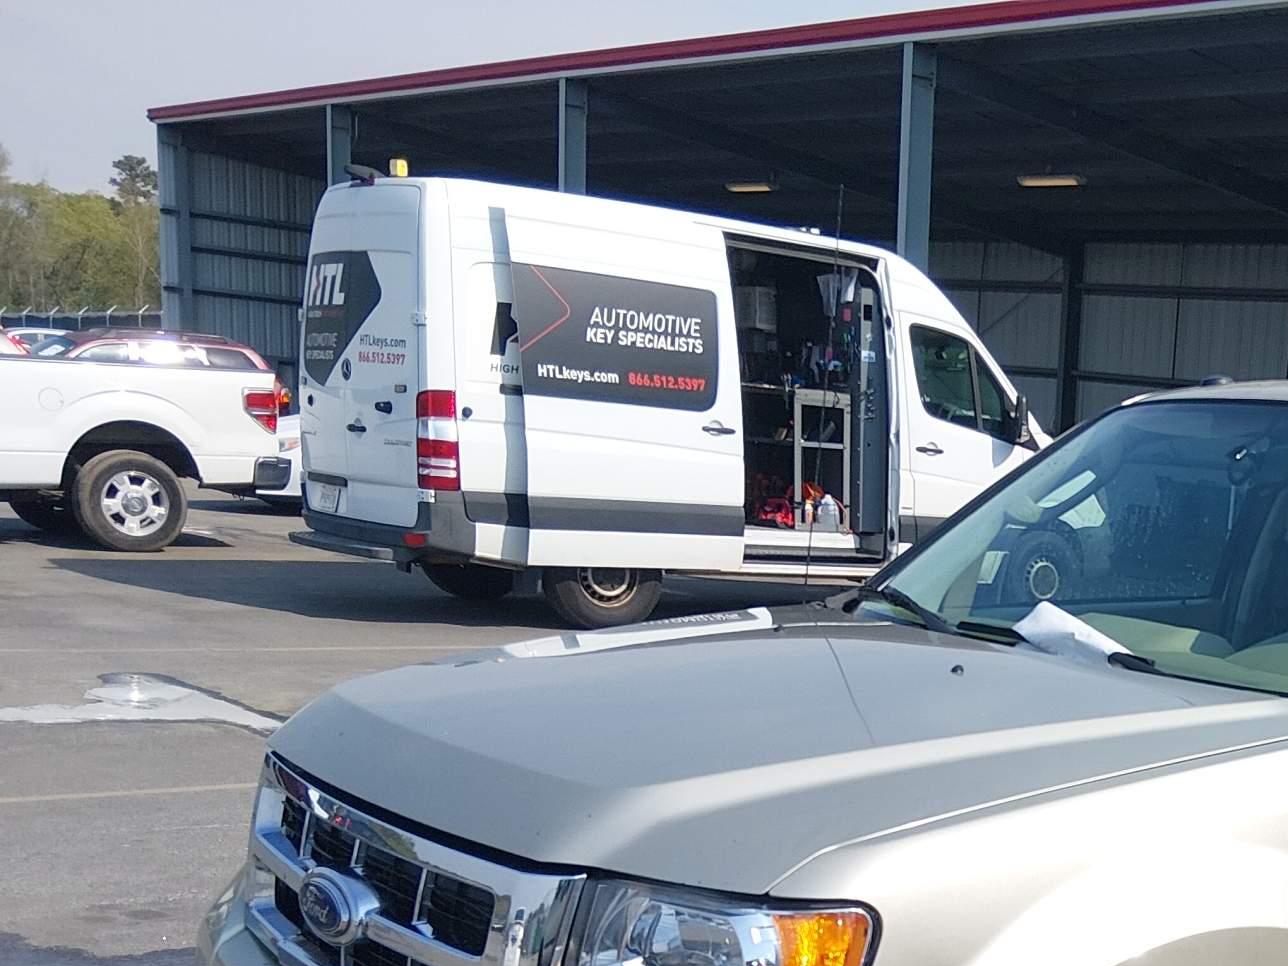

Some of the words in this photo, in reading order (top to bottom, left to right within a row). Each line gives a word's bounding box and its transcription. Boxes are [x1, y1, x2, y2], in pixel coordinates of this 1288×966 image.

[308, 263, 345, 306] HTL
[590, 306, 702, 337] AUTOMOTIVE
[359, 334, 407, 349] HTLkeys.com
[586, 327, 615, 344] KEY
[618, 330, 704, 354] SPECIALISTS
[358, 351, 406, 365] 866.512.5397
[490, 363, 520, 374] HIGH
[537, 363, 620, 384] HTLkeys.com
[628, 372, 706, 392] 866.512.5397
